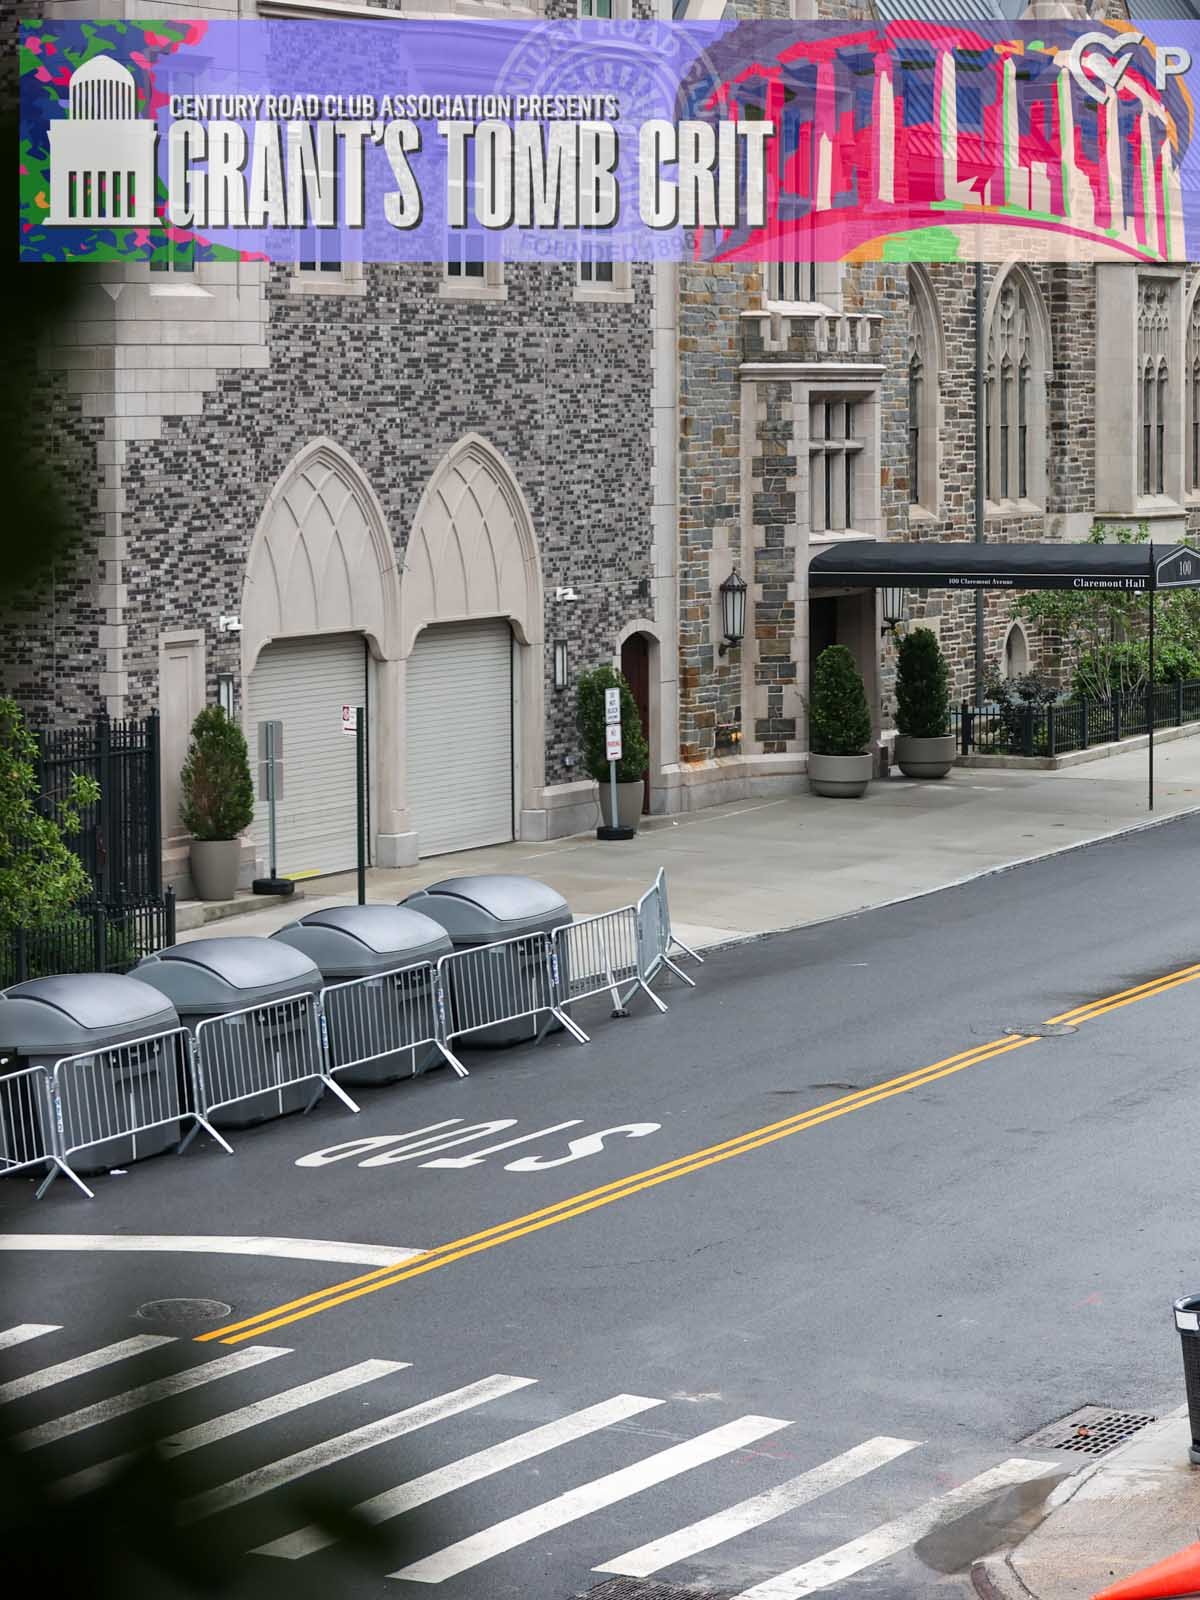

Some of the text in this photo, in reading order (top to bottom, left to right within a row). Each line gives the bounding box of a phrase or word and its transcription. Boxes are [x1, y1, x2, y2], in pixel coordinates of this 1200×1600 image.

[1179, 560, 1192, 577] 100
[1073, 578, 1146, 588] Claremont Hall
[294, 1118, 662, 1172] STOP
